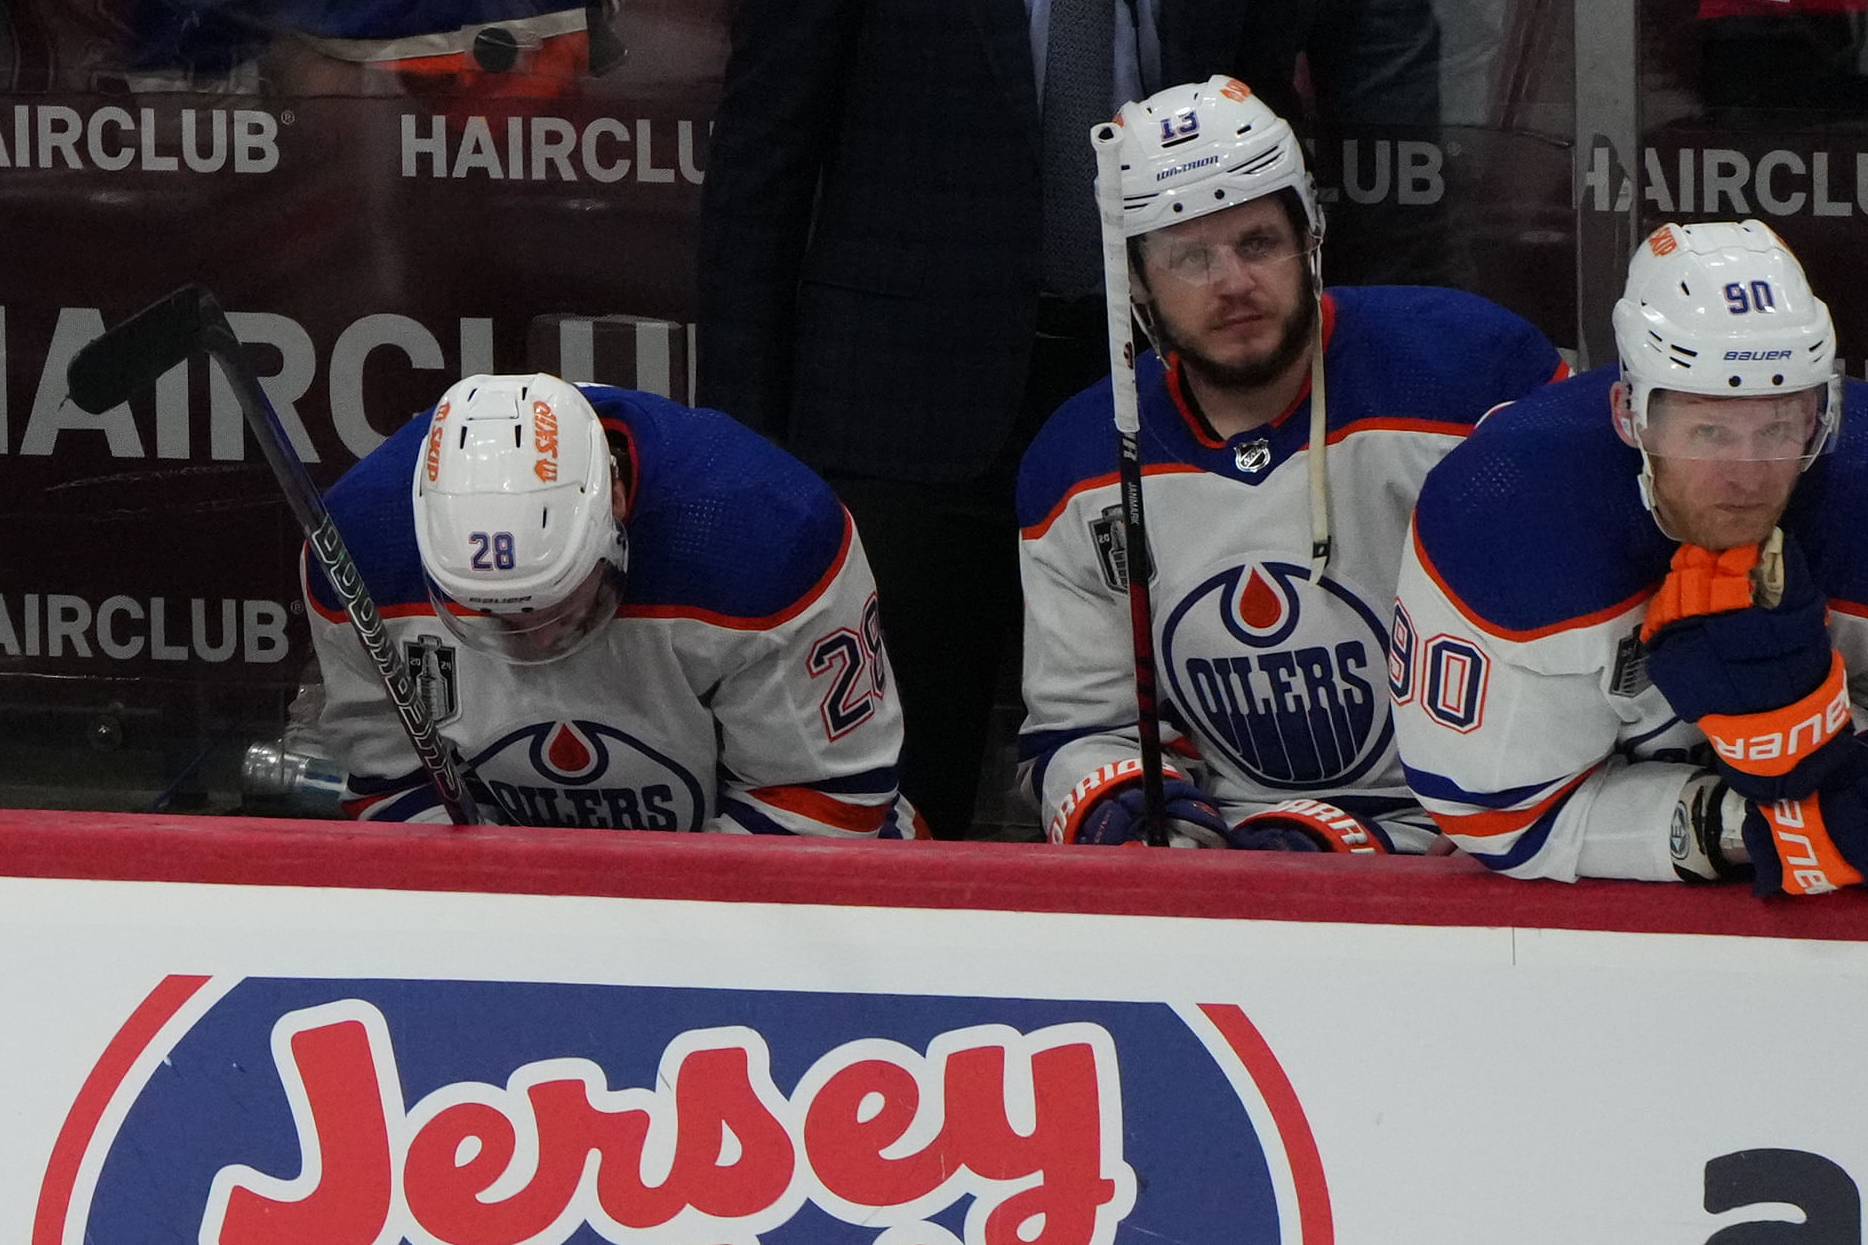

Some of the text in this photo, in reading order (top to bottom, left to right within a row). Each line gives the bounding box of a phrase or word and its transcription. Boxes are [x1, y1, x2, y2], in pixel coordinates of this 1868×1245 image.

[400, 113, 714, 187] HAIRCLU
[1160, 110, 1201, 142] 13
[1724, 279, 1776, 315] 90
[1723, 349, 1793, 362] BAUER
[427, 425, 444, 483] SKIP
[533, 400, 559, 460] SKIP
[468, 530, 516, 572] 28
[805, 590, 887, 743] 28
[1388, 594, 1491, 735] 90
[1185, 638, 1375, 754] OILERS
[490, 779, 676, 832] OILERS
[210, 1012, 1122, 1245] Jersey
